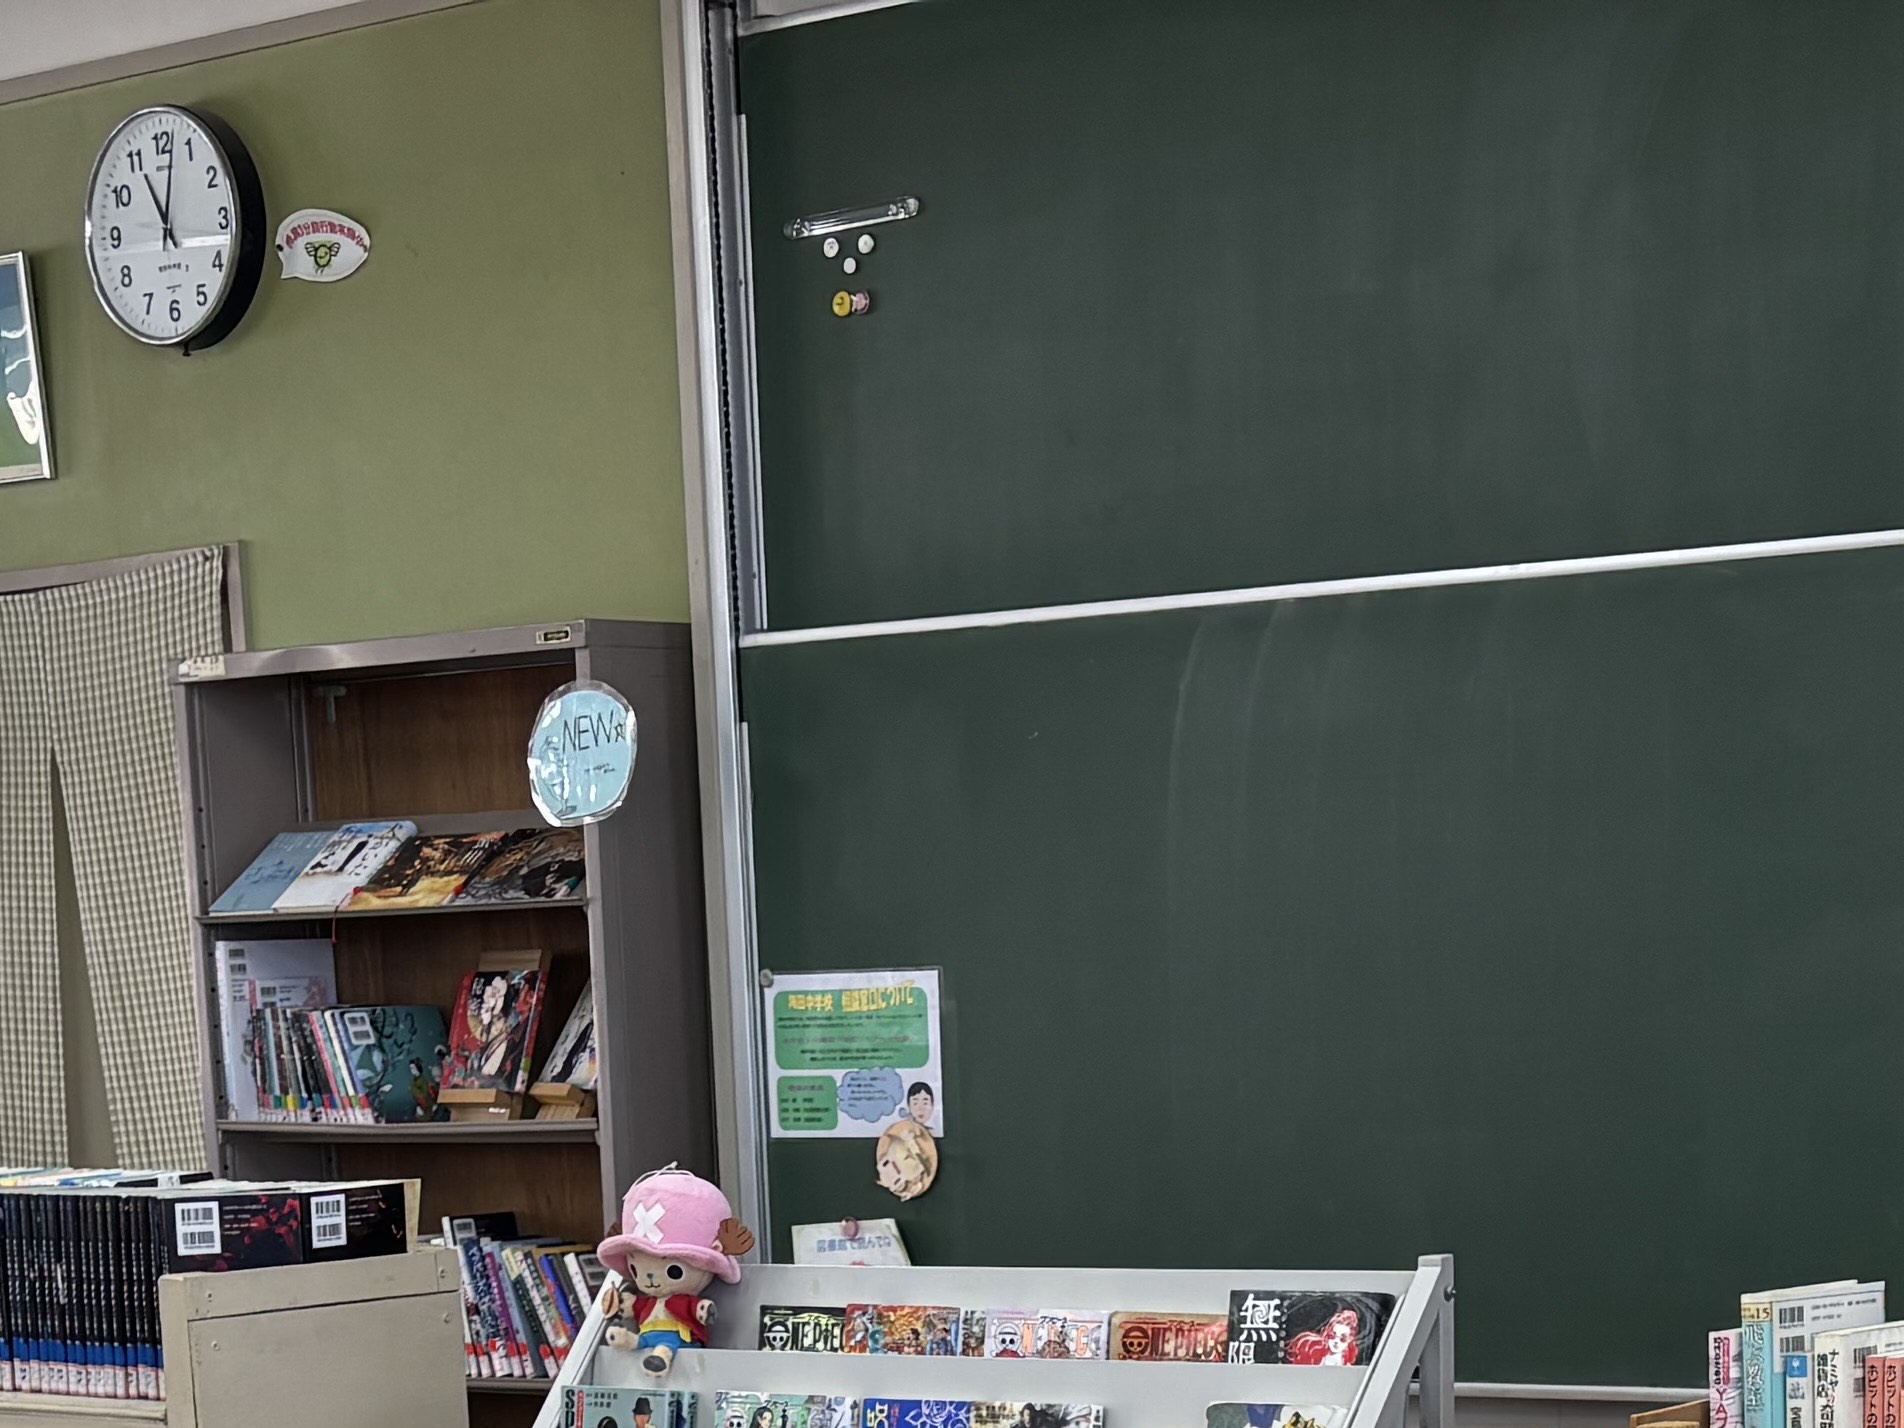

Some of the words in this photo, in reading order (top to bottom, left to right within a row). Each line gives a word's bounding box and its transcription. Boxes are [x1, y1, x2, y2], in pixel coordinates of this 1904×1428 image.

[151, 131, 170, 155] 12
[185, 138, 194, 161] 1
[126, 149, 143, 173] 11
[206, 165, 218, 188] 2
[111, 184, 132, 208] 10
[218, 207, 230, 230] 3
[110, 226, 122, 249] 9
[212, 250, 224, 272] 4
[120, 265, 133, 287] 8
[143, 293, 154, 316] 7
[196, 284, 208, 306] 5
[169, 300, 182, 322] 6
